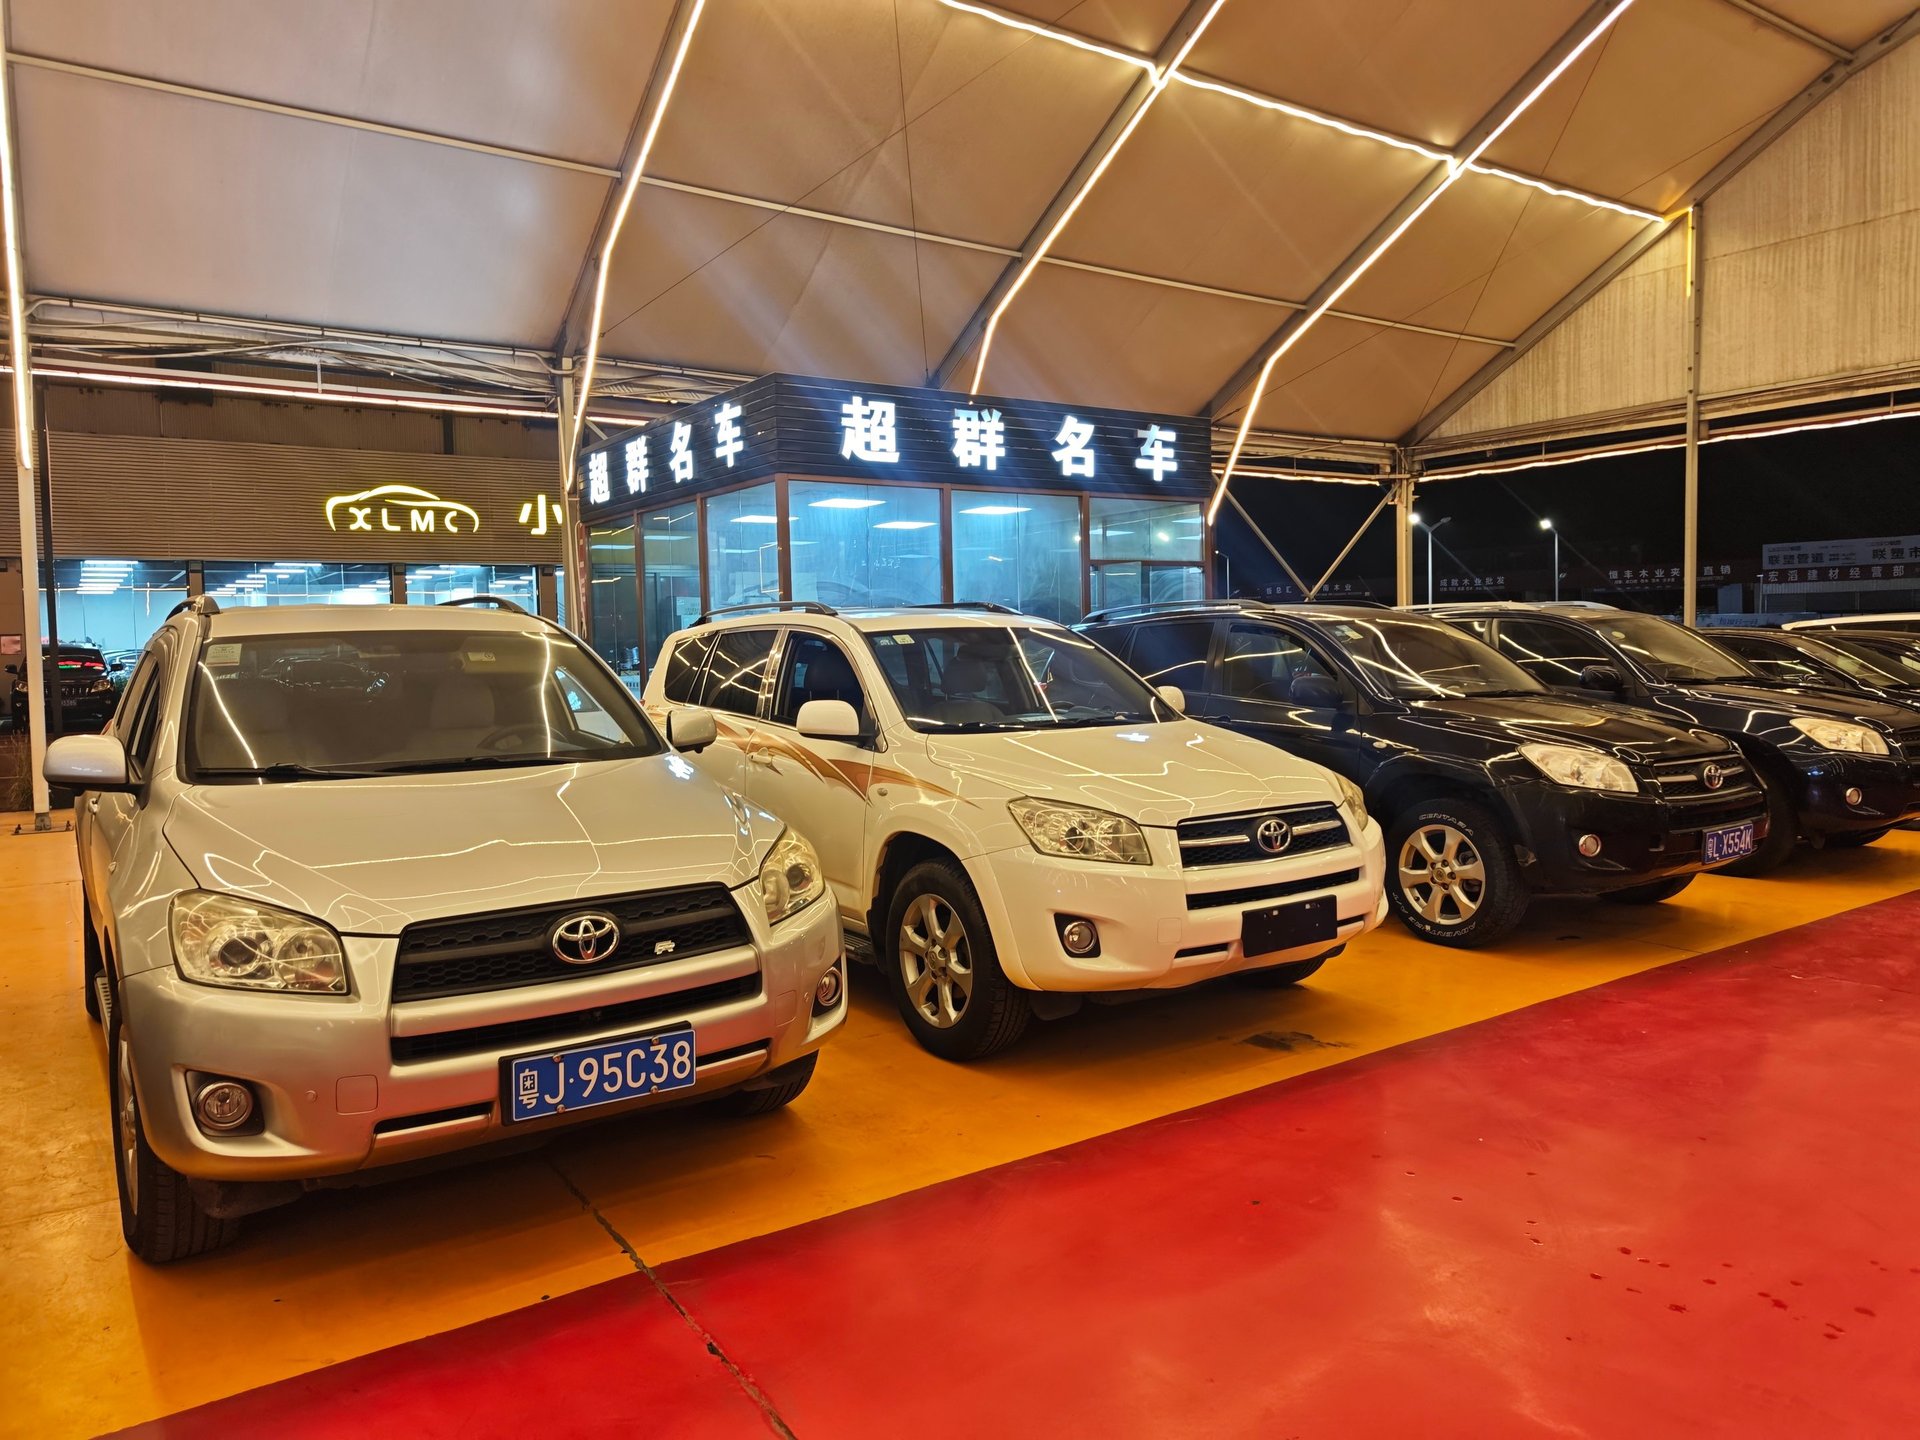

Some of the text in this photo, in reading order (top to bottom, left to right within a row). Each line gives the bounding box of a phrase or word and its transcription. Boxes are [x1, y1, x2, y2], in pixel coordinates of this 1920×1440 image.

[588, 402, 743, 505] 超群名车
[839, 396, 1178, 481] 超群名车
[518, 1039, 693, 1110] 粤J·95C38
